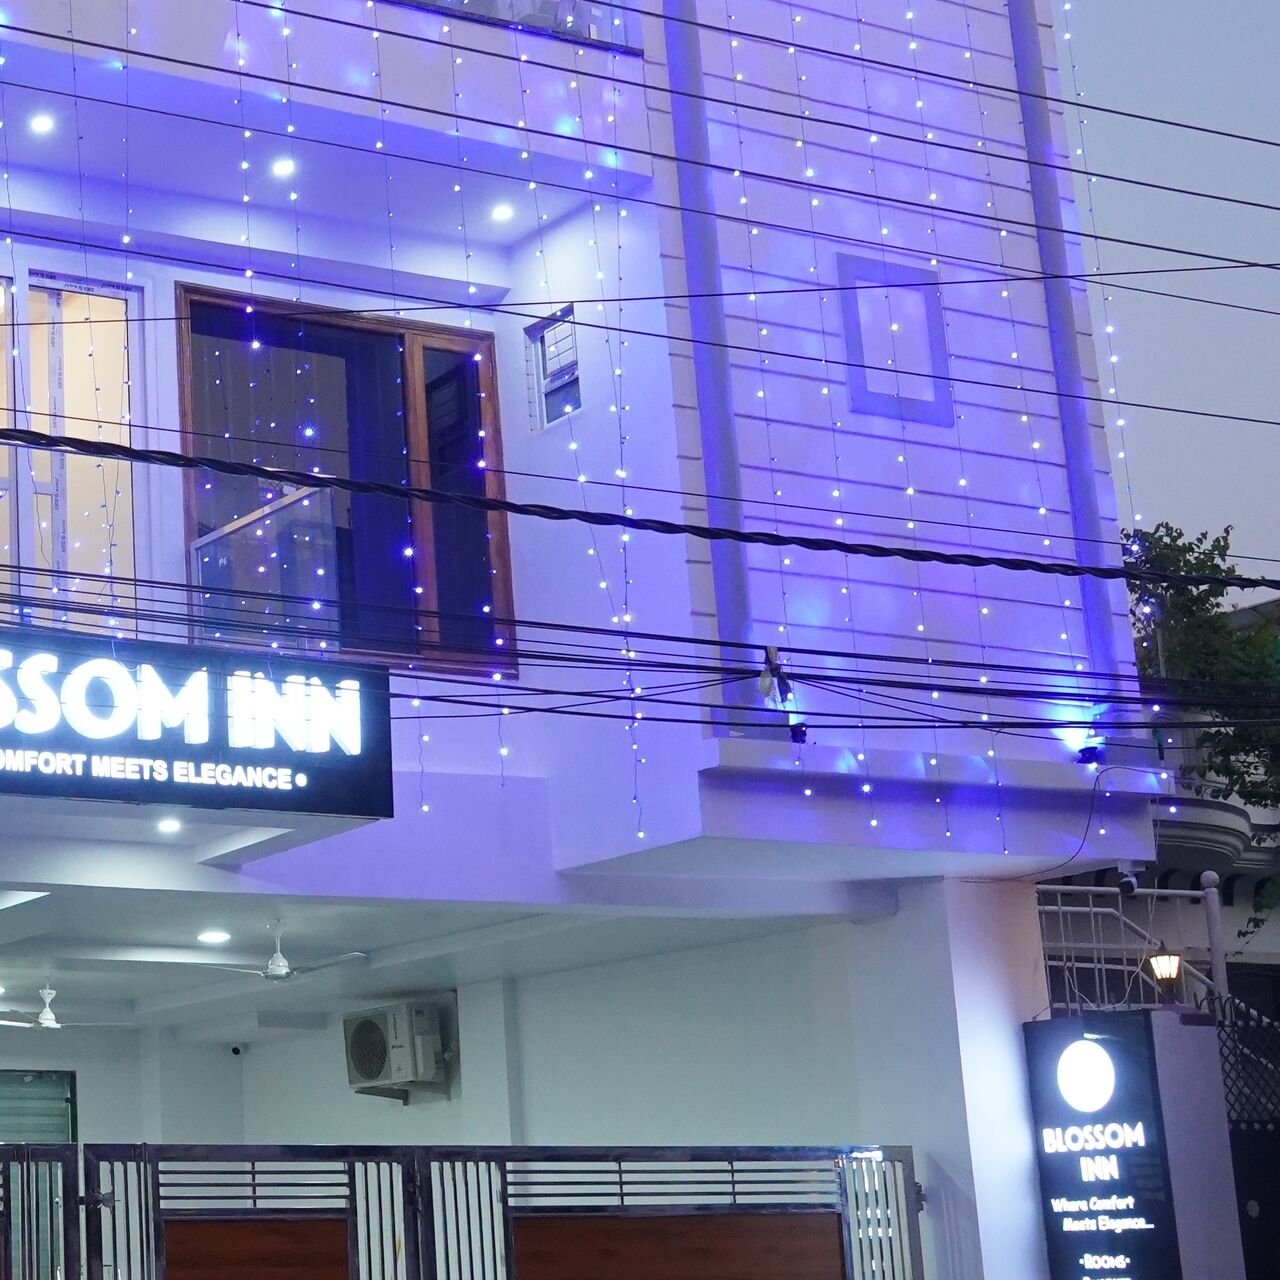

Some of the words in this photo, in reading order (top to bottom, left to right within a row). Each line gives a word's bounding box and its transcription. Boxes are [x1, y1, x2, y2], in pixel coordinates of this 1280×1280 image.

[226, 670, 362, 756] INN
[91, 755, 169, 782] MEETS
[173, 760, 293, 790] ELEGANCE
[1042, 1121, 1146, 1154] BLOSSOM
[1079, 1154, 1120, 1182] INN
